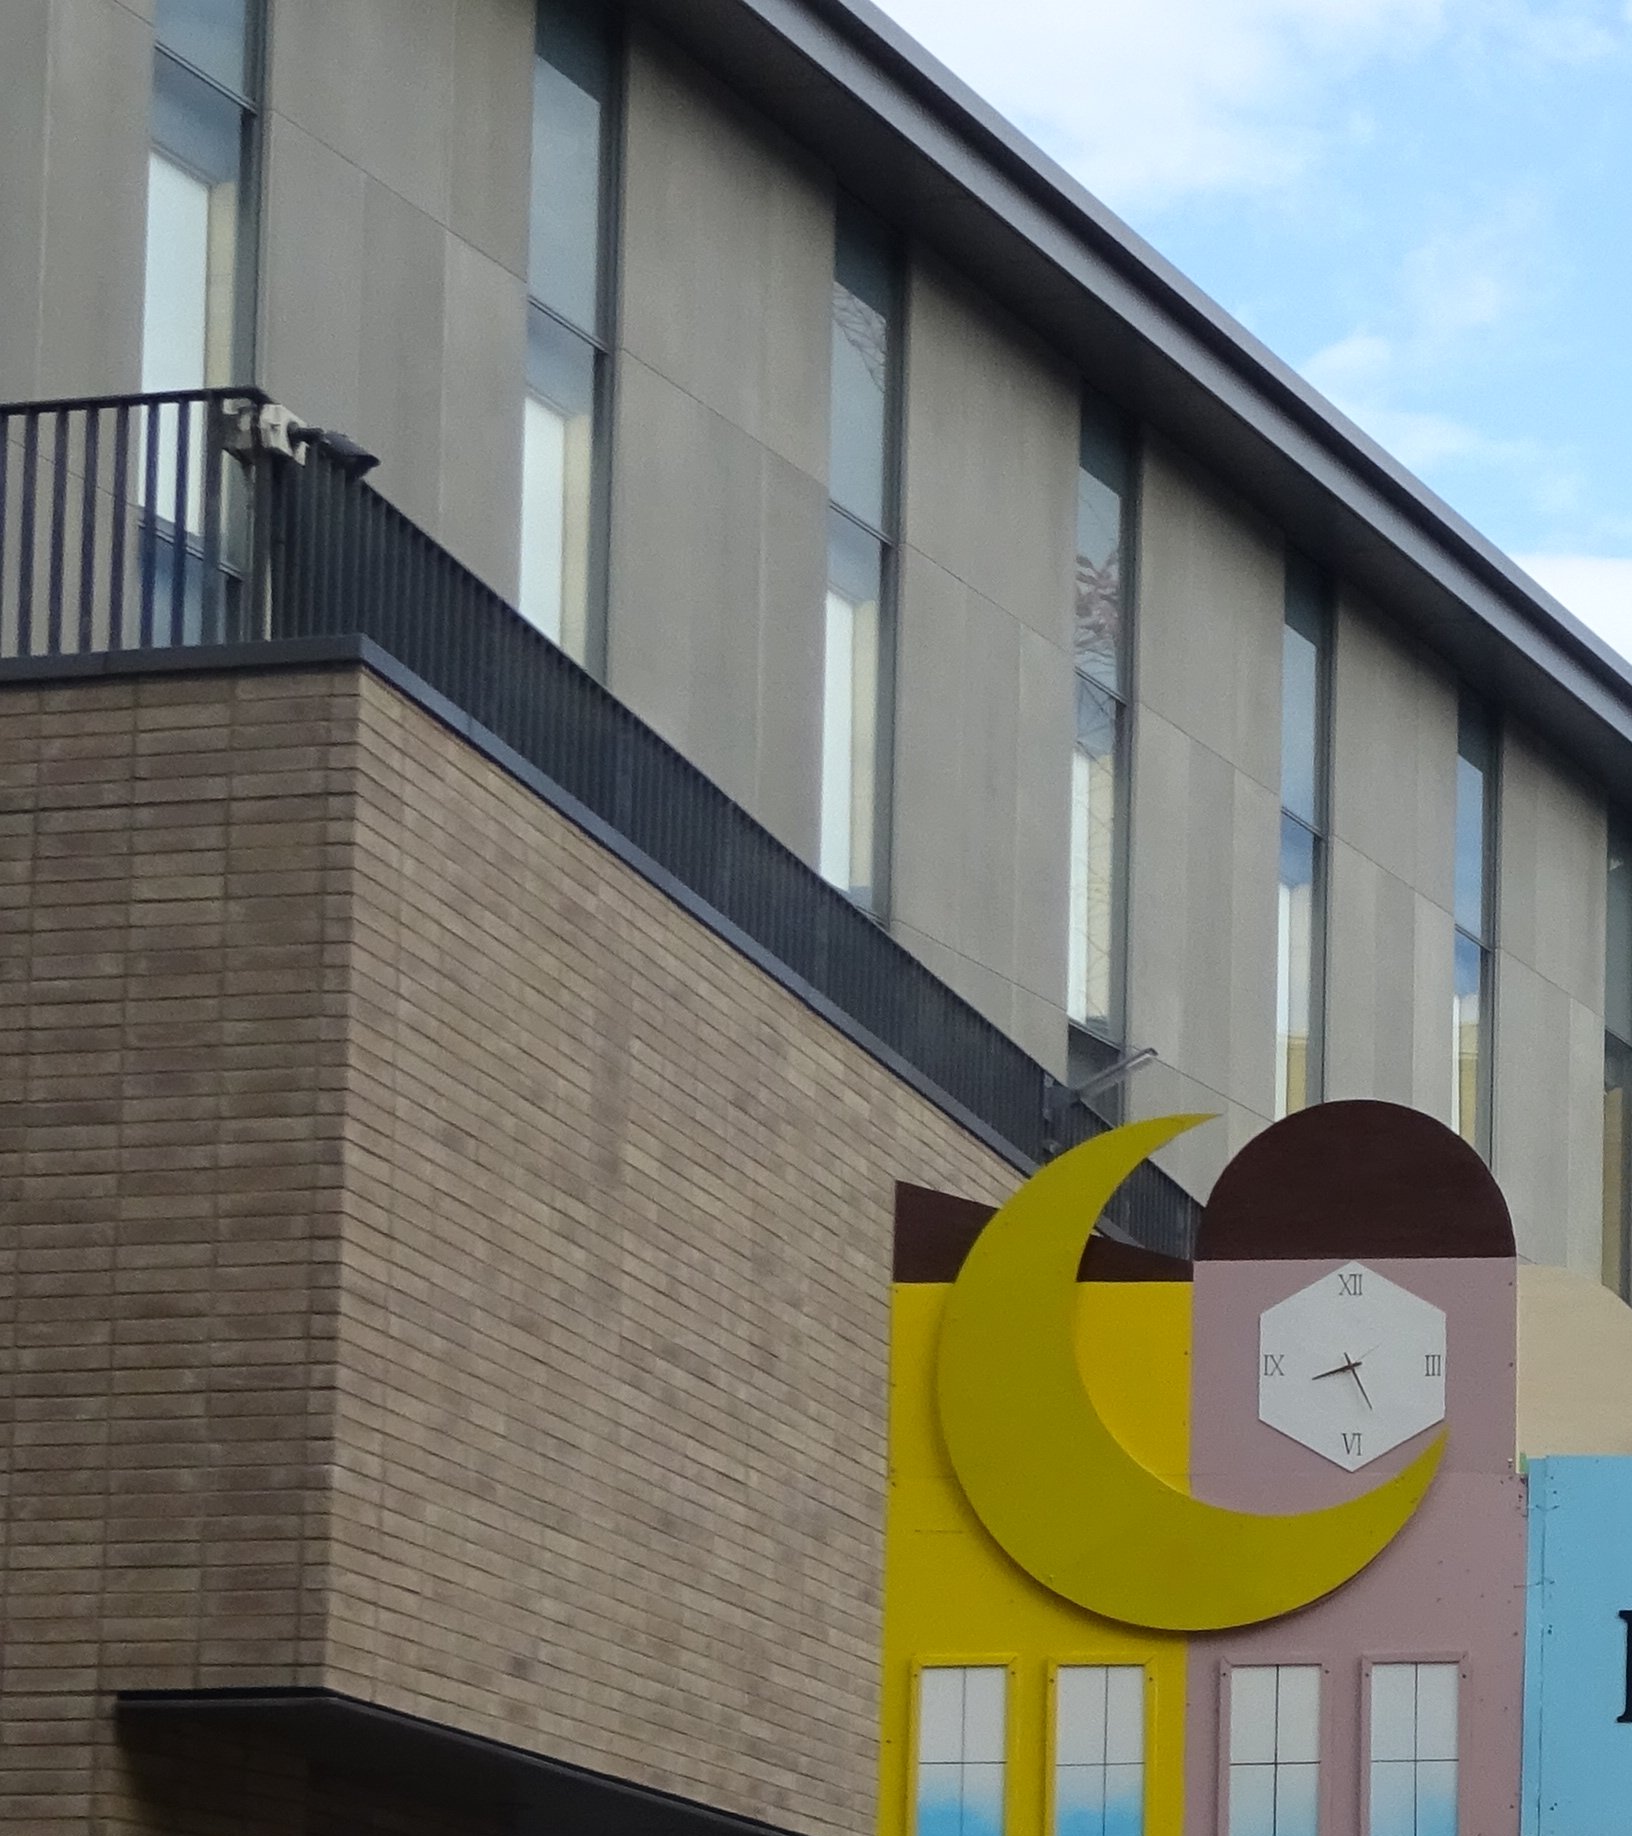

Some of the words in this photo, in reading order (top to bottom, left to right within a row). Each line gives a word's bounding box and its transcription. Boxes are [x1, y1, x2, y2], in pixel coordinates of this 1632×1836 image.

[1338, 1273, 1363, 1296] XII
[1263, 1354, 1285, 1377] IX
[1424, 1354, 1441, 1377] III
[1341, 1432, 1363, 1456] VI
